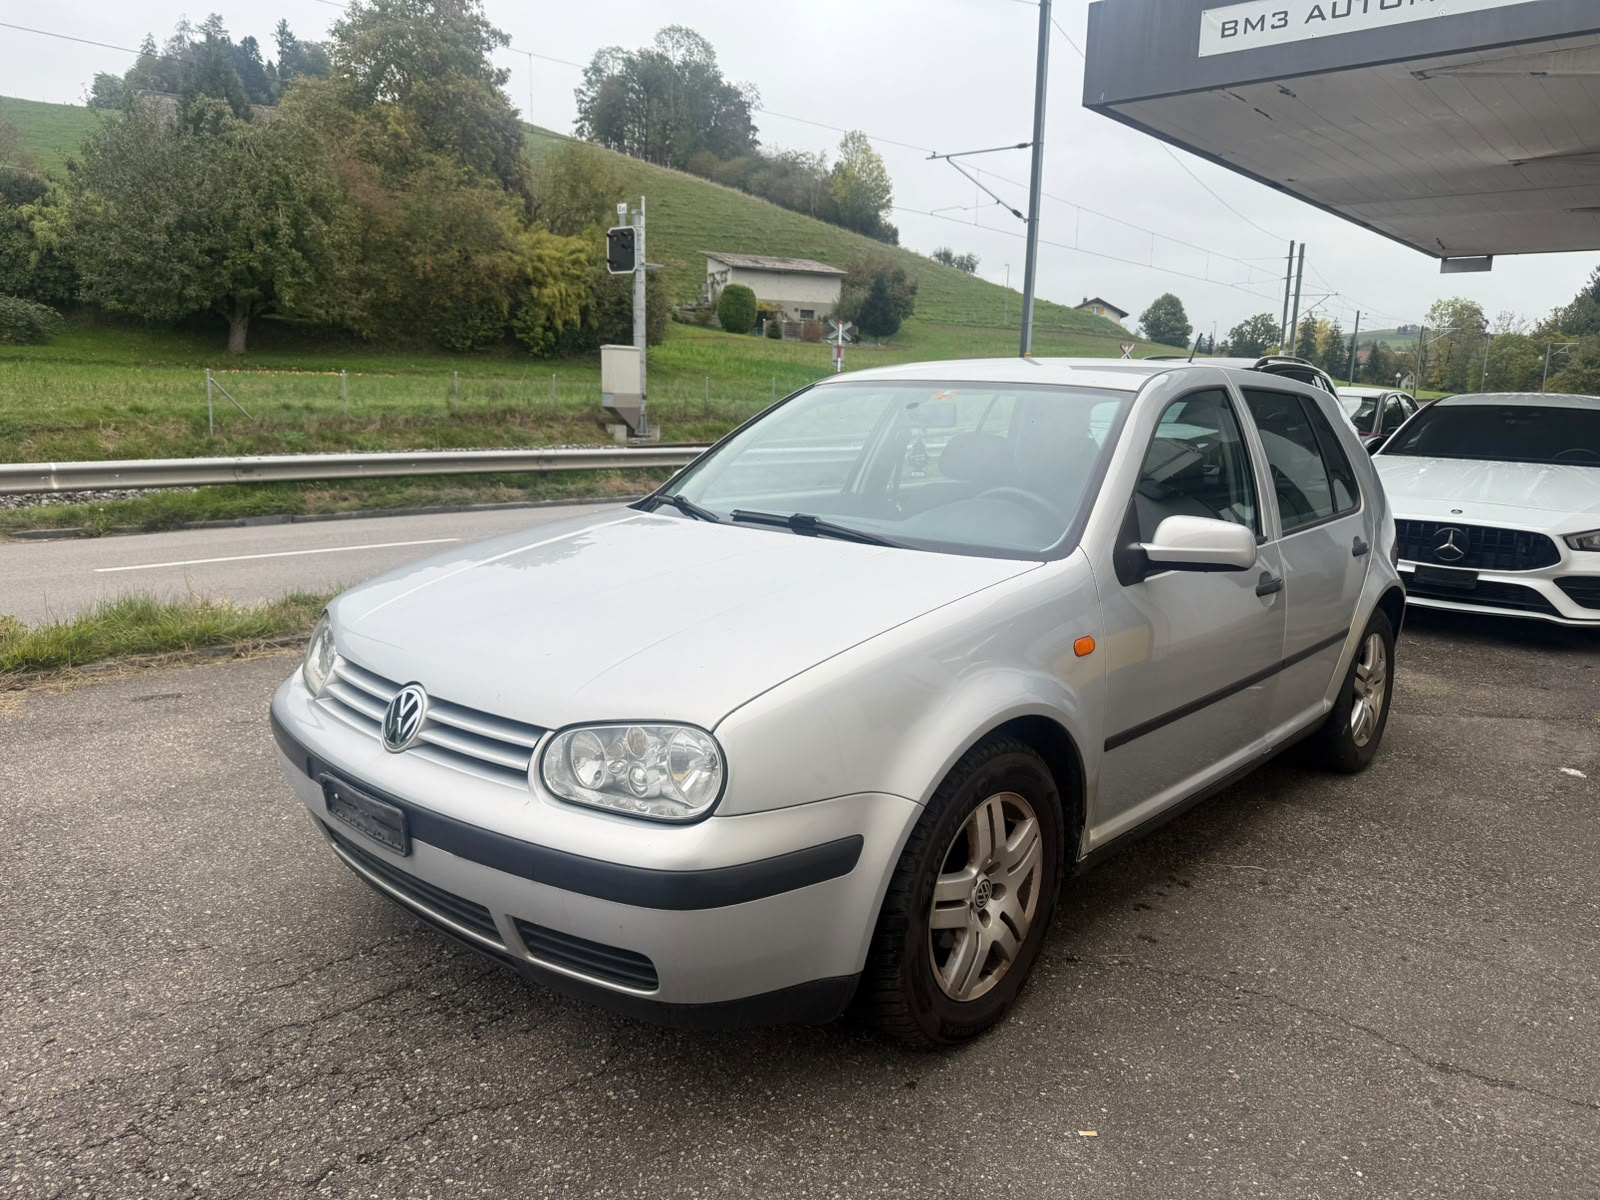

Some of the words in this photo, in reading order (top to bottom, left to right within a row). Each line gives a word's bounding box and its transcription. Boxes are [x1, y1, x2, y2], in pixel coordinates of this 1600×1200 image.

[1220, 10, 1289, 39] BM3
[1303, 0, 1434, 24] AUT
[384, 688, 424, 747] VW
